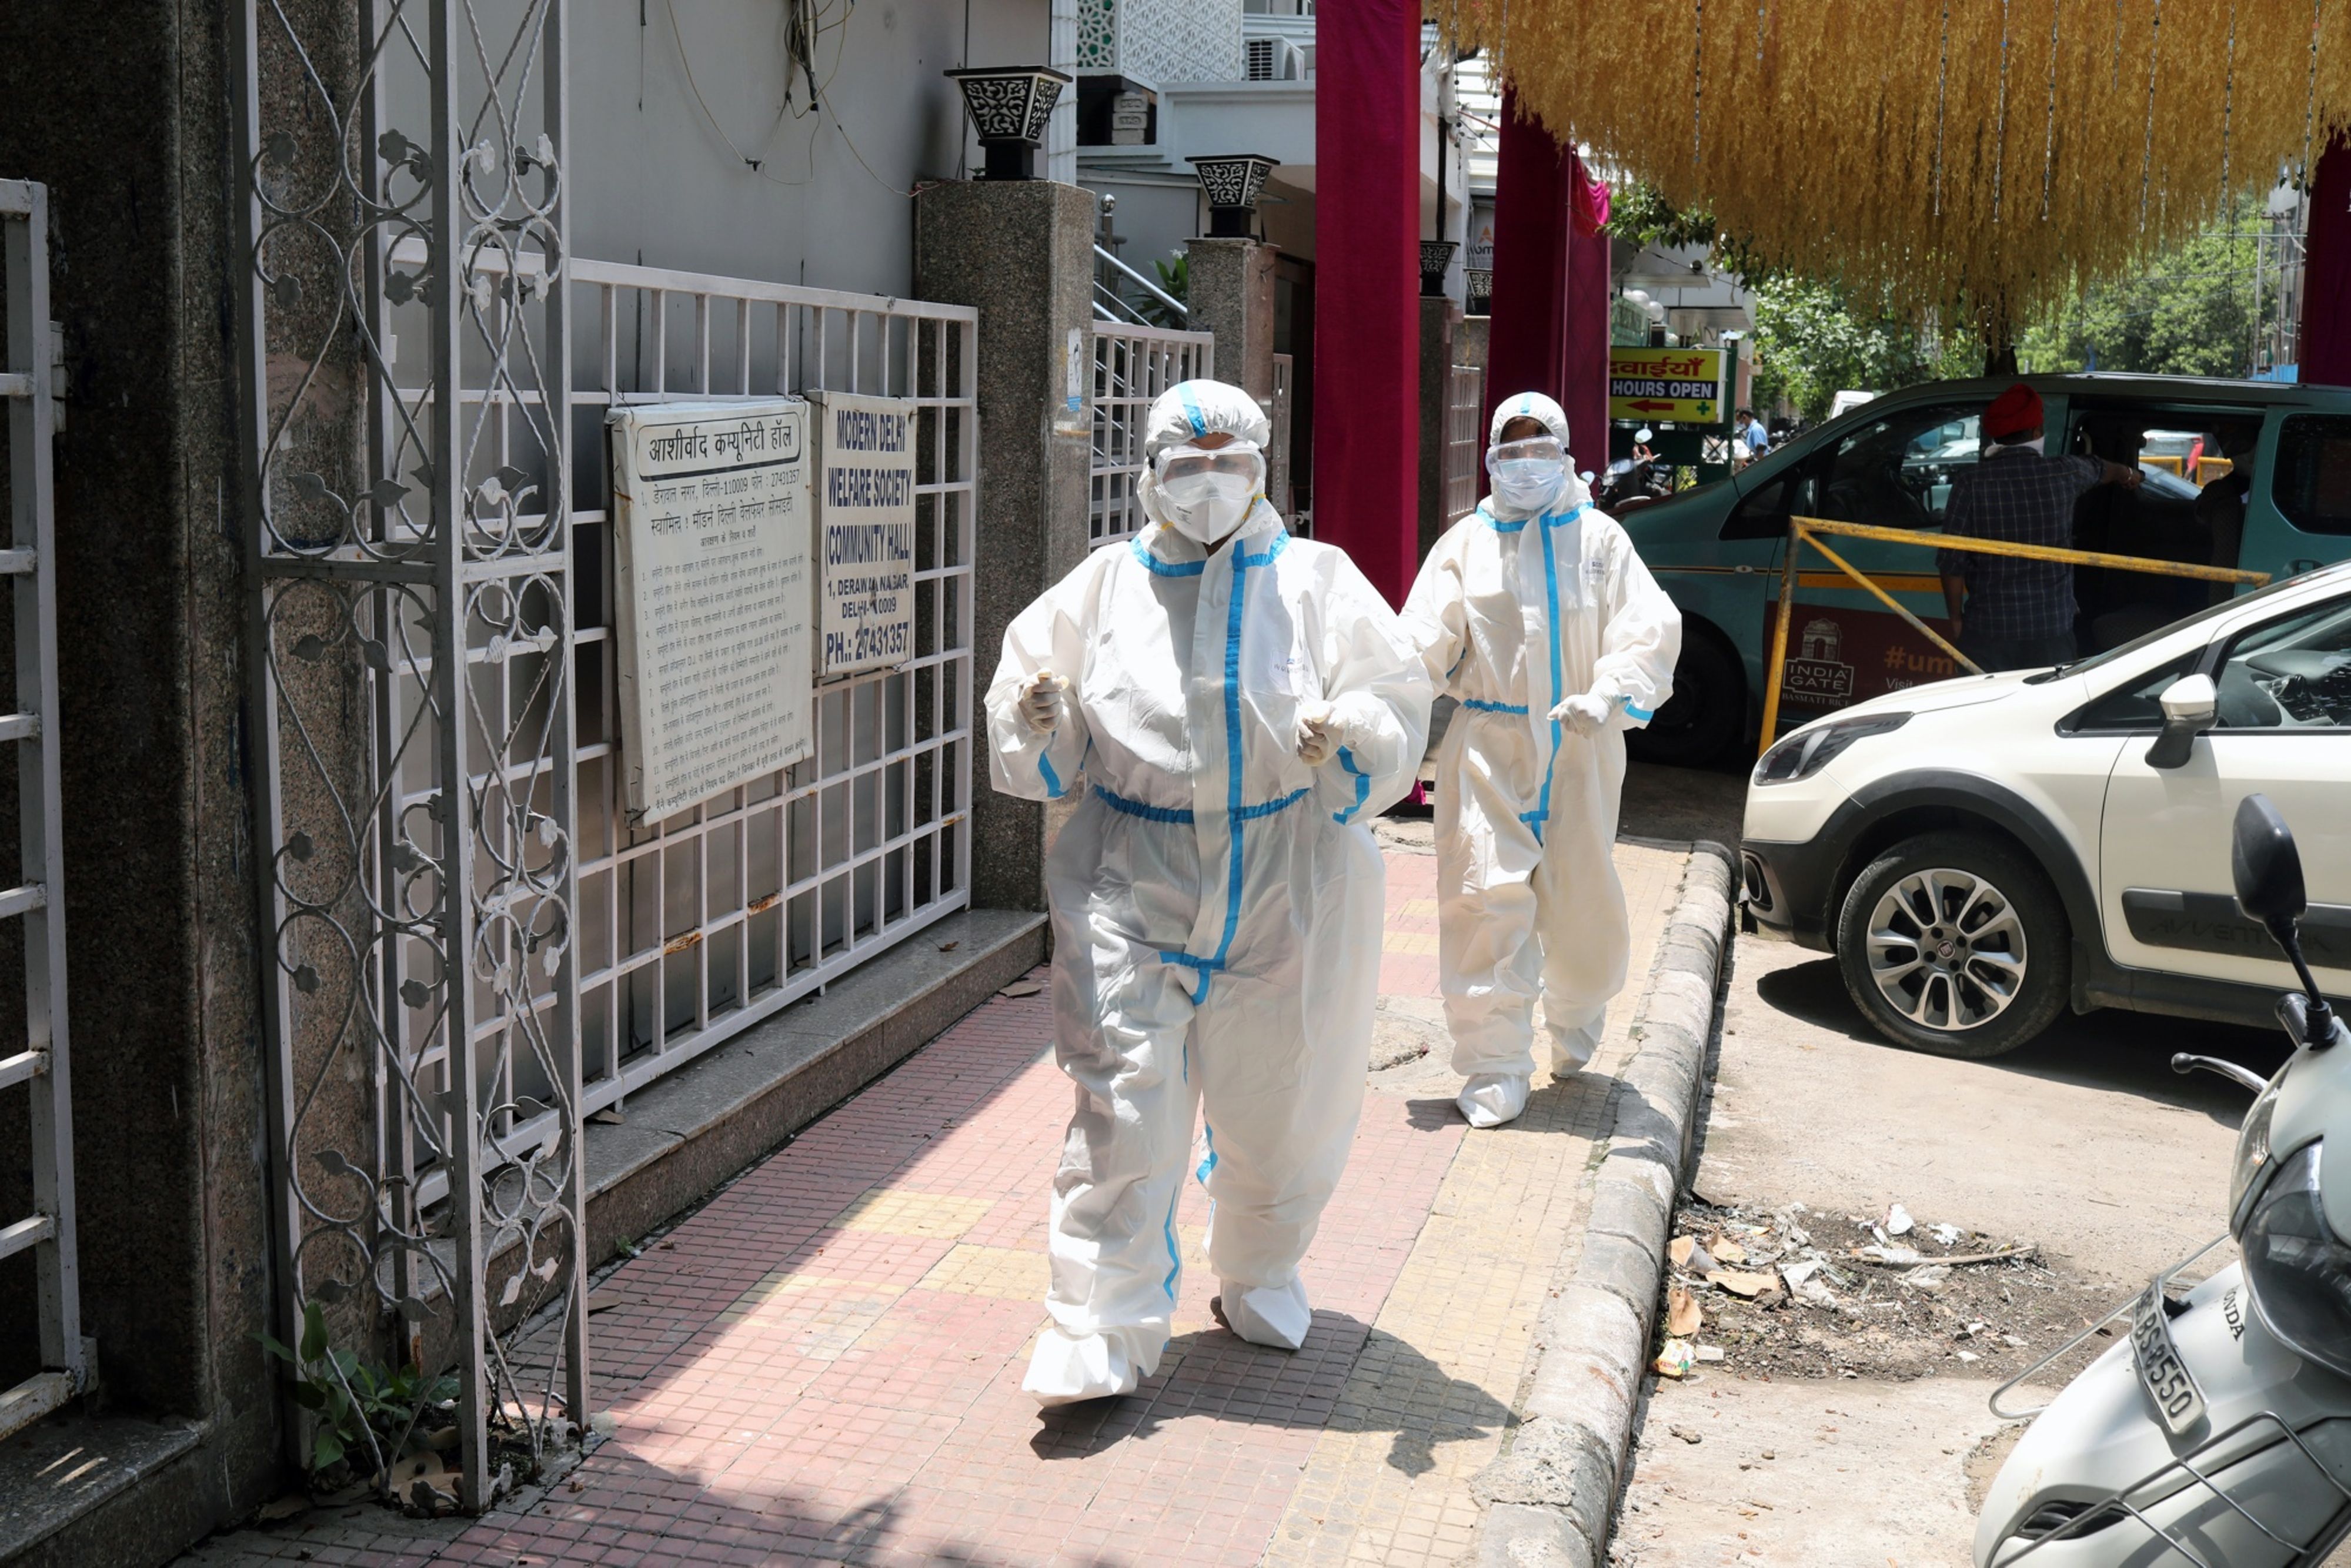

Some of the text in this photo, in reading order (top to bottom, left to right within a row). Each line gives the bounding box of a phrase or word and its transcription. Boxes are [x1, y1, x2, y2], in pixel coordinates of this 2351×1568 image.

[1612, 380, 1712, 398] HOURS OPEN
[649, 419, 792, 462] आशीर्वाद कम्यूनिटी हॉल
[836, 410, 905, 452] MODERN DELHI
[772, 469, 800, 487] 27431357
[829, 467, 911, 507] WELFARE SOCIETY
[693, 504, 713, 530] मॉडर्न
[717, 502, 736, 526] दिल्ली
[826, 523, 911, 576] (COMMUNITY HALL)
[827, 580, 835, 600] 1,
[827, 631, 851, 665] PH.:
[856, 621, 909, 660] 27431357
[1791, 664, 1846, 680] INDIA
[1791, 676, 1844, 691] GATE
[1886, 677, 1913, 690] Visit
[1782, 692, 1825, 704] BASMATI
